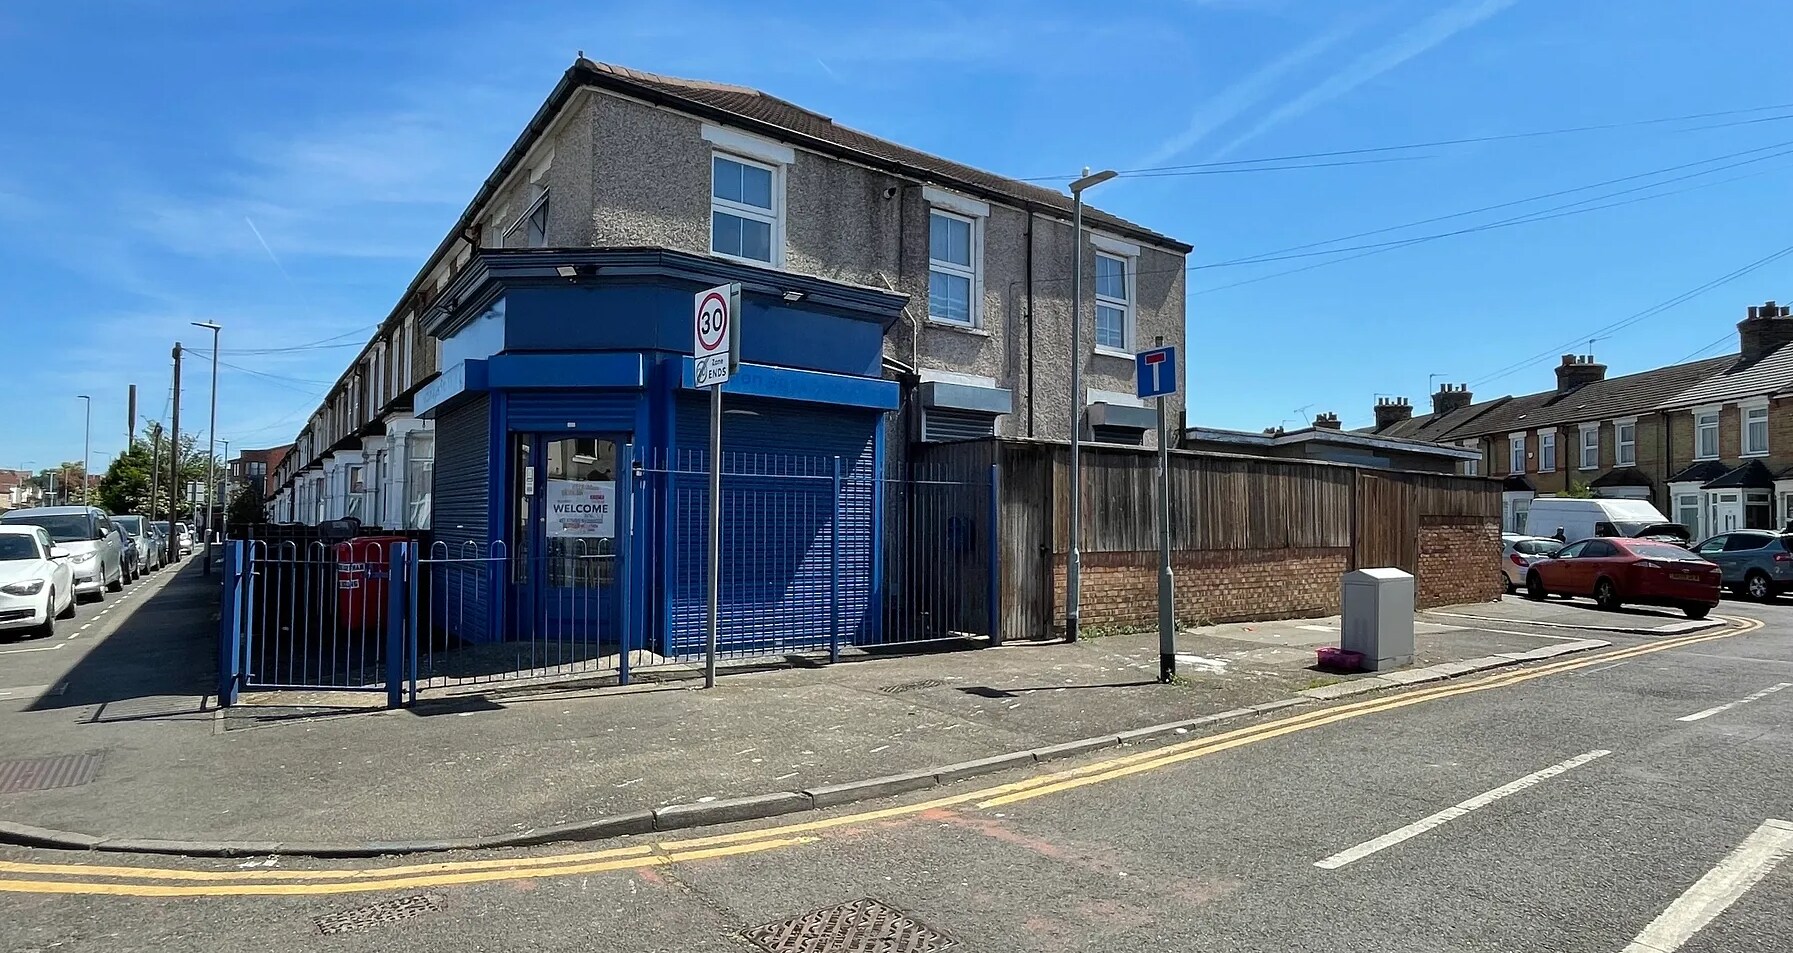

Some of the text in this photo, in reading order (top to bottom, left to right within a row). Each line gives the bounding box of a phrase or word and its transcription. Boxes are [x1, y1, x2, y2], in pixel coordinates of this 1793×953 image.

[701, 308, 723, 335] 30
[712, 358, 724, 366] Zone
[708, 366, 727, 379] ENDS
[553, 504, 609, 513] WELCOME
